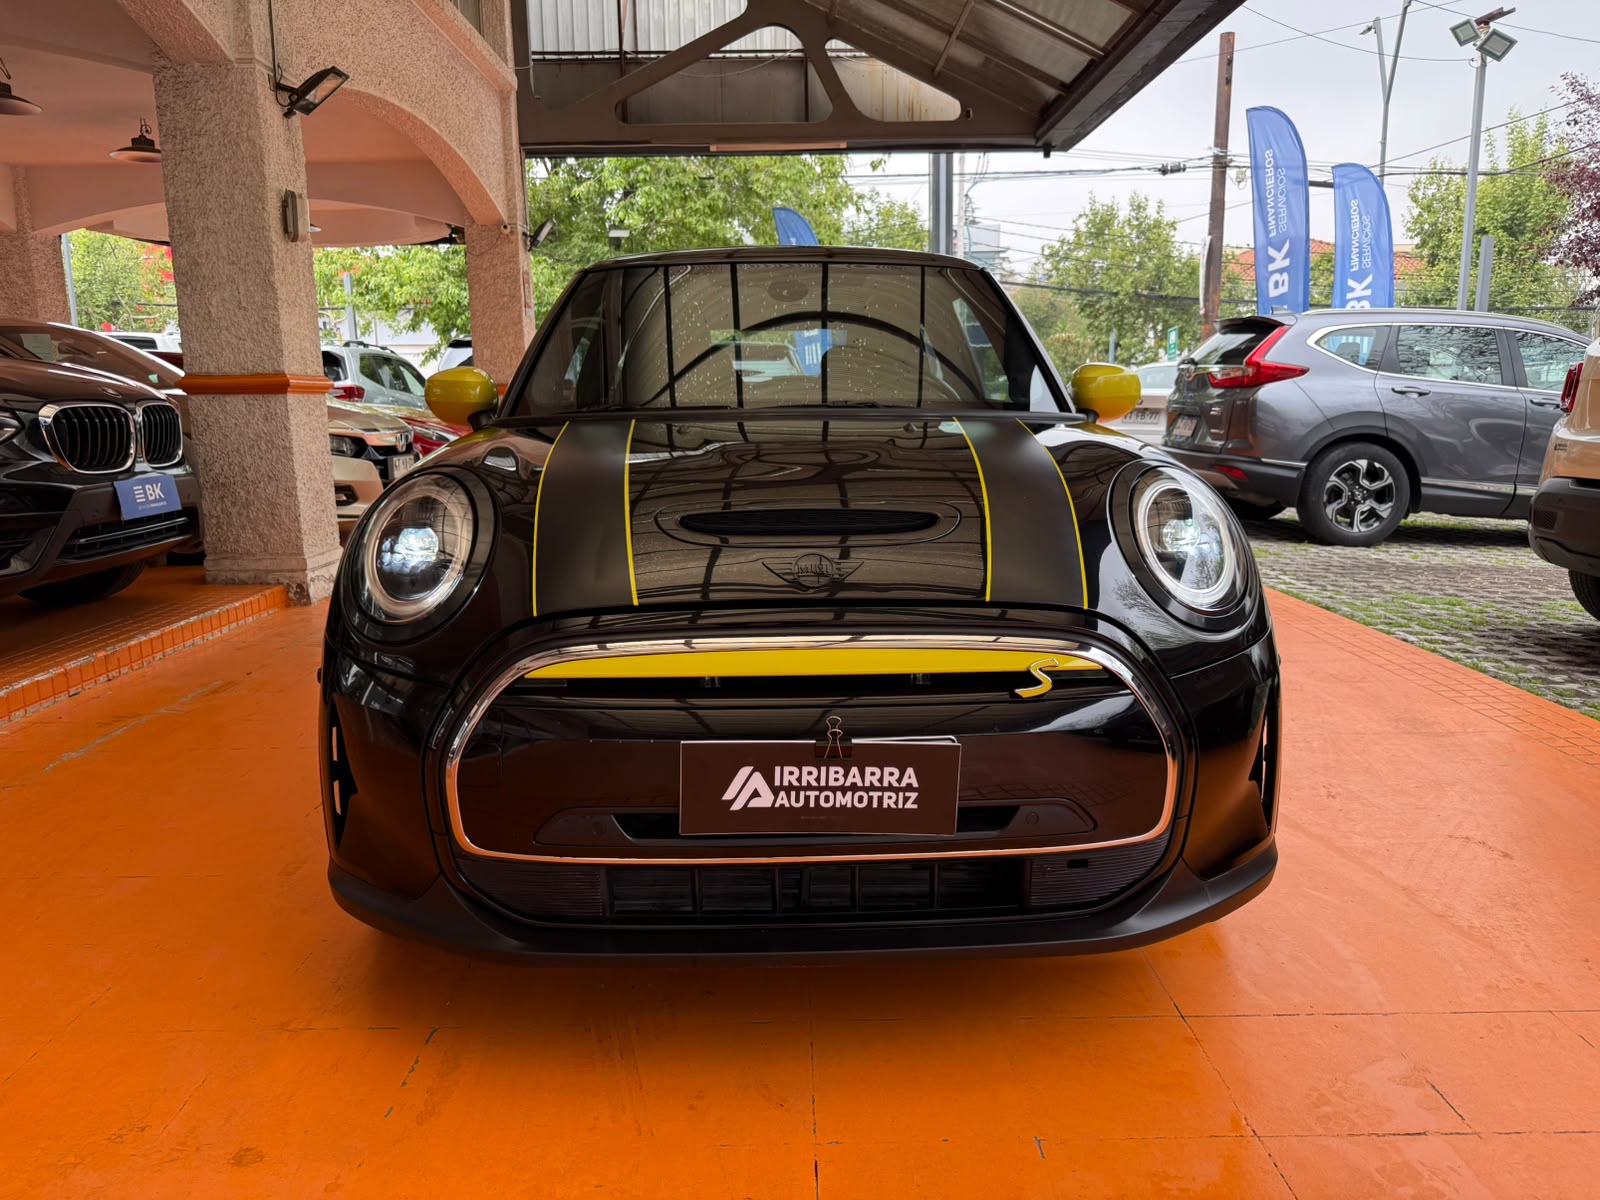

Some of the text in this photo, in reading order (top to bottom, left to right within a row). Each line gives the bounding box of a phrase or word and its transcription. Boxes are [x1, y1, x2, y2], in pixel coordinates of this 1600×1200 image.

[145, 482, 165, 500] BK
[1014, 657, 1060, 699] S
[774, 765, 919, 788] IRRIBARRA
[774, 790, 919, 809] AUTOMOTRIZ
